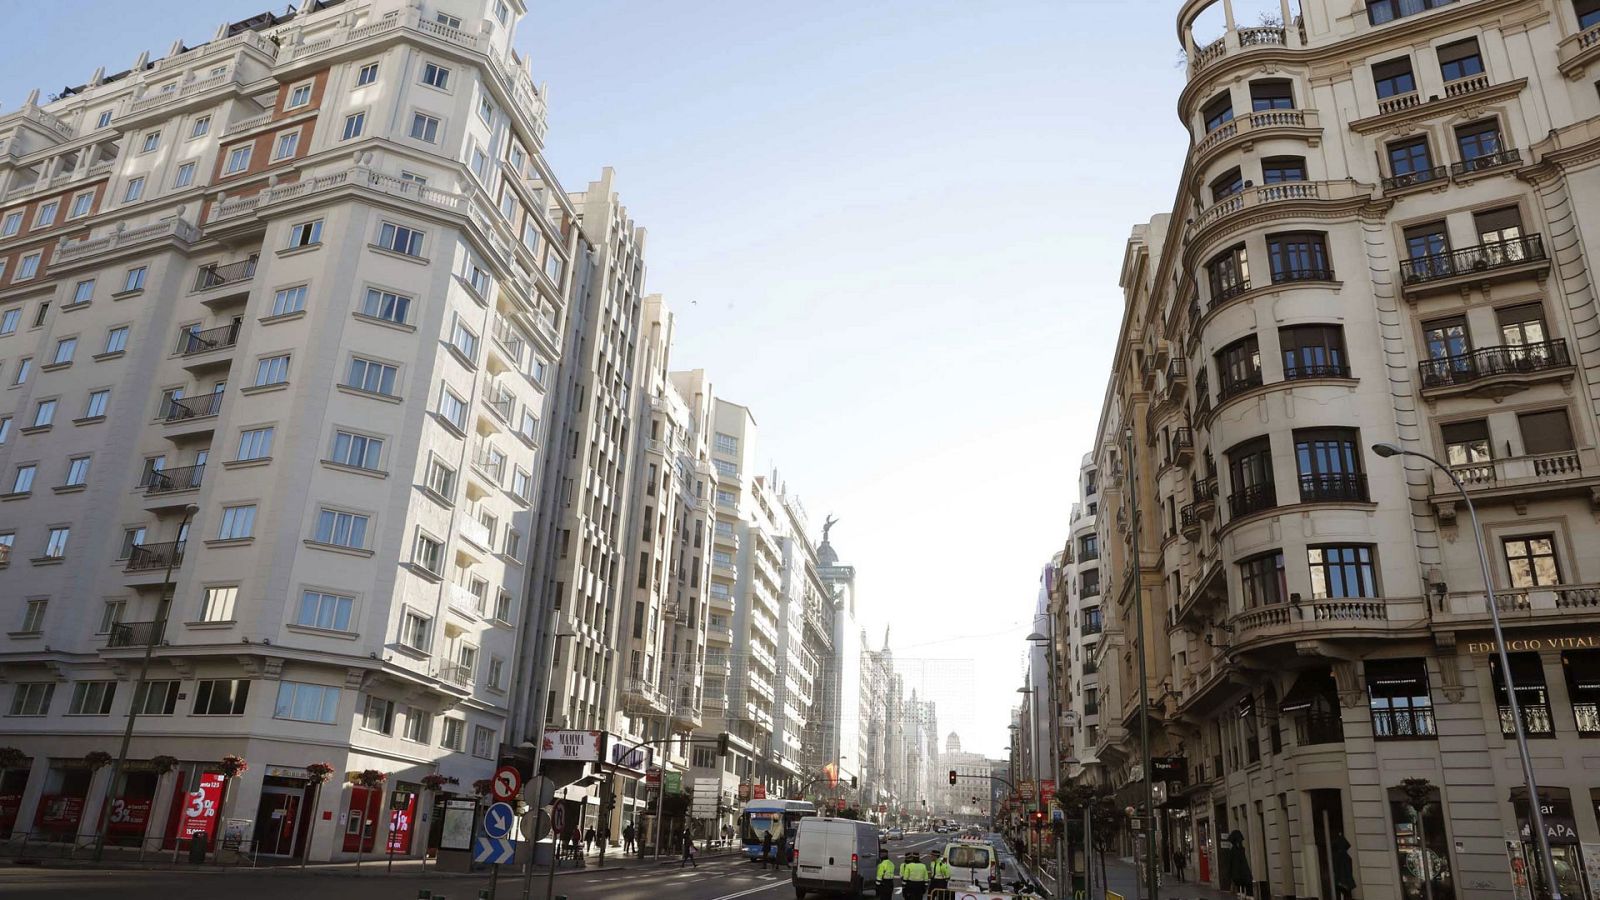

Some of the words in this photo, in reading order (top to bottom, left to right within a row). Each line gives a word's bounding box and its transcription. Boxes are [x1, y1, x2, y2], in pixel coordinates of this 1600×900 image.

[1468, 639, 1541, 653] EDIICIO
[560, 733, 585, 745] MAMMA
[186, 788, 215, 817] 3%
[1540, 804, 1554, 814] ar
[1544, 823, 1577, 838] APA
